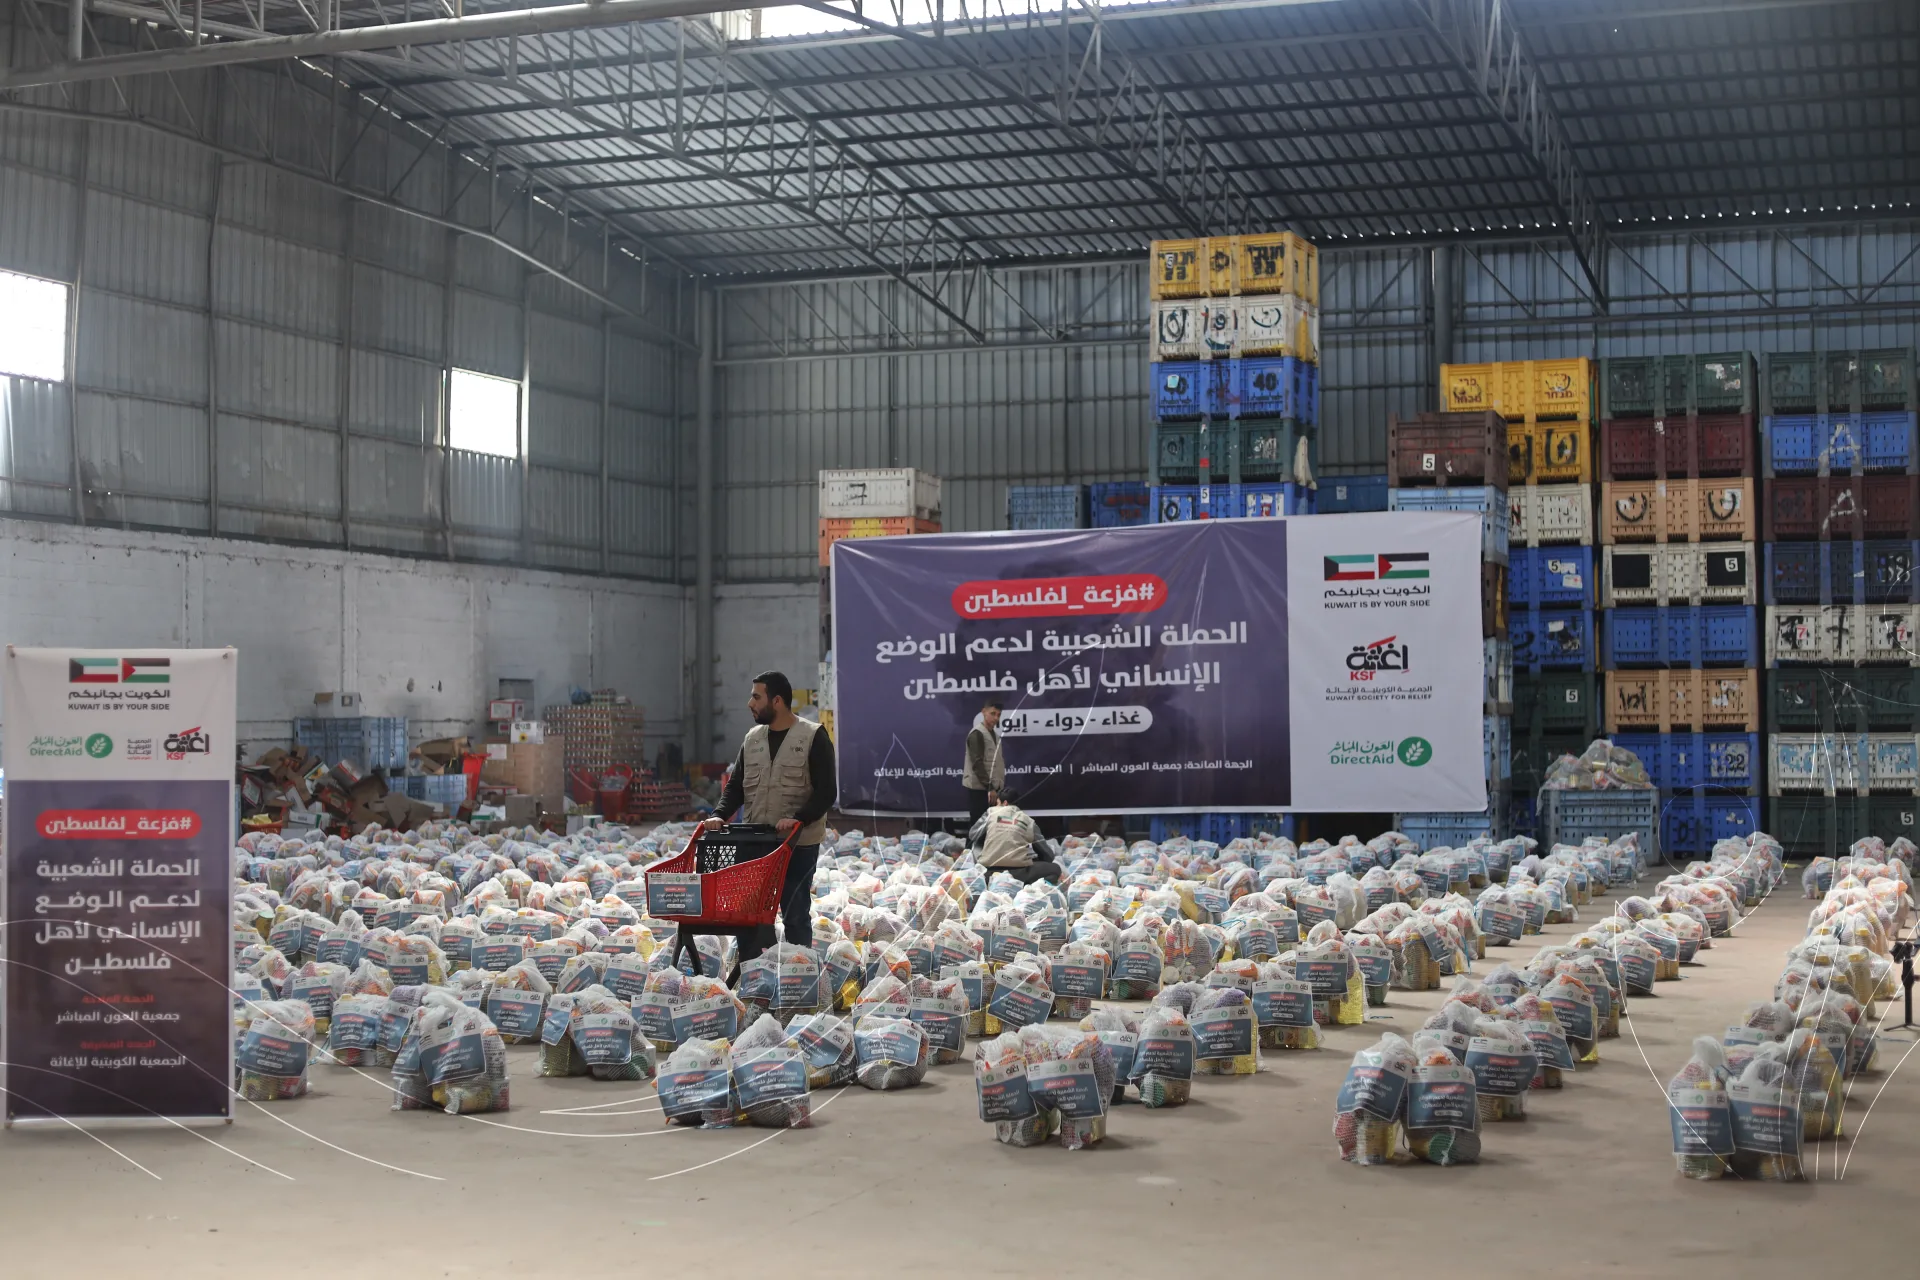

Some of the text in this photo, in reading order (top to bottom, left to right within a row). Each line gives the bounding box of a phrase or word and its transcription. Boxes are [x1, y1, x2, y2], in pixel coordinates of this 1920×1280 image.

[1253, 372, 1277, 391] 40
[1425, 457, 1433, 468] 5
[1202, 488, 1208, 499] 5
[1552, 560, 1559, 571] 5
[1728, 560, 1736, 570] 5
[1324, 585, 1430, 598] الكويت بجانبكم
[964, 583, 1155, 613] #فزعة_لفلسطين
[1324, 601, 1357, 609] KUWAIT
[1370, 600, 1381, 608] BY
[1410, 599, 1430, 607] SIDE
[1797, 627, 1807, 639] 7
[876, 621, 1247, 663] الحملة الشعبية لدعم الوضع
[903, 662, 1220, 700] الإنساني لأهل فلسطين
[68, 690, 170, 700] الكويت بجانبكم
[1569, 689, 1576, 701] 5
[1045, 712, 1084, 729] دواء
[1102, 710, 1142, 726] غذاء
[30, 747, 82, 756] DirectAid
[1331, 753, 1394, 765] DirectAid
[1034, 764, 1062, 774] الجهة
[1081, 763, 1117, 775] المباشر
[1121, 762, 1148, 774] العون
[1151, 762, 1182, 774] جمعية
[1224, 760, 1253, 771] الجهة
[874, 767, 905, 780] للإغاثة
[910, 766, 943, 778] الكويتية
[1904, 812, 1911, 823] 5
[45, 816, 192, 834] #فزعة_لفلسطين
[36, 857, 200, 881] الحملة الشعبية
[35, 890, 200, 914] لدعم الوضع
[35, 920, 200, 944] الإنساني لأهل
[65, 952, 171, 975] فلسطين
[56, 1011, 180, 1024] جمعية العون المباشر
[50, 1056, 186, 1069] الجمعية الكويتية للإغاثة
